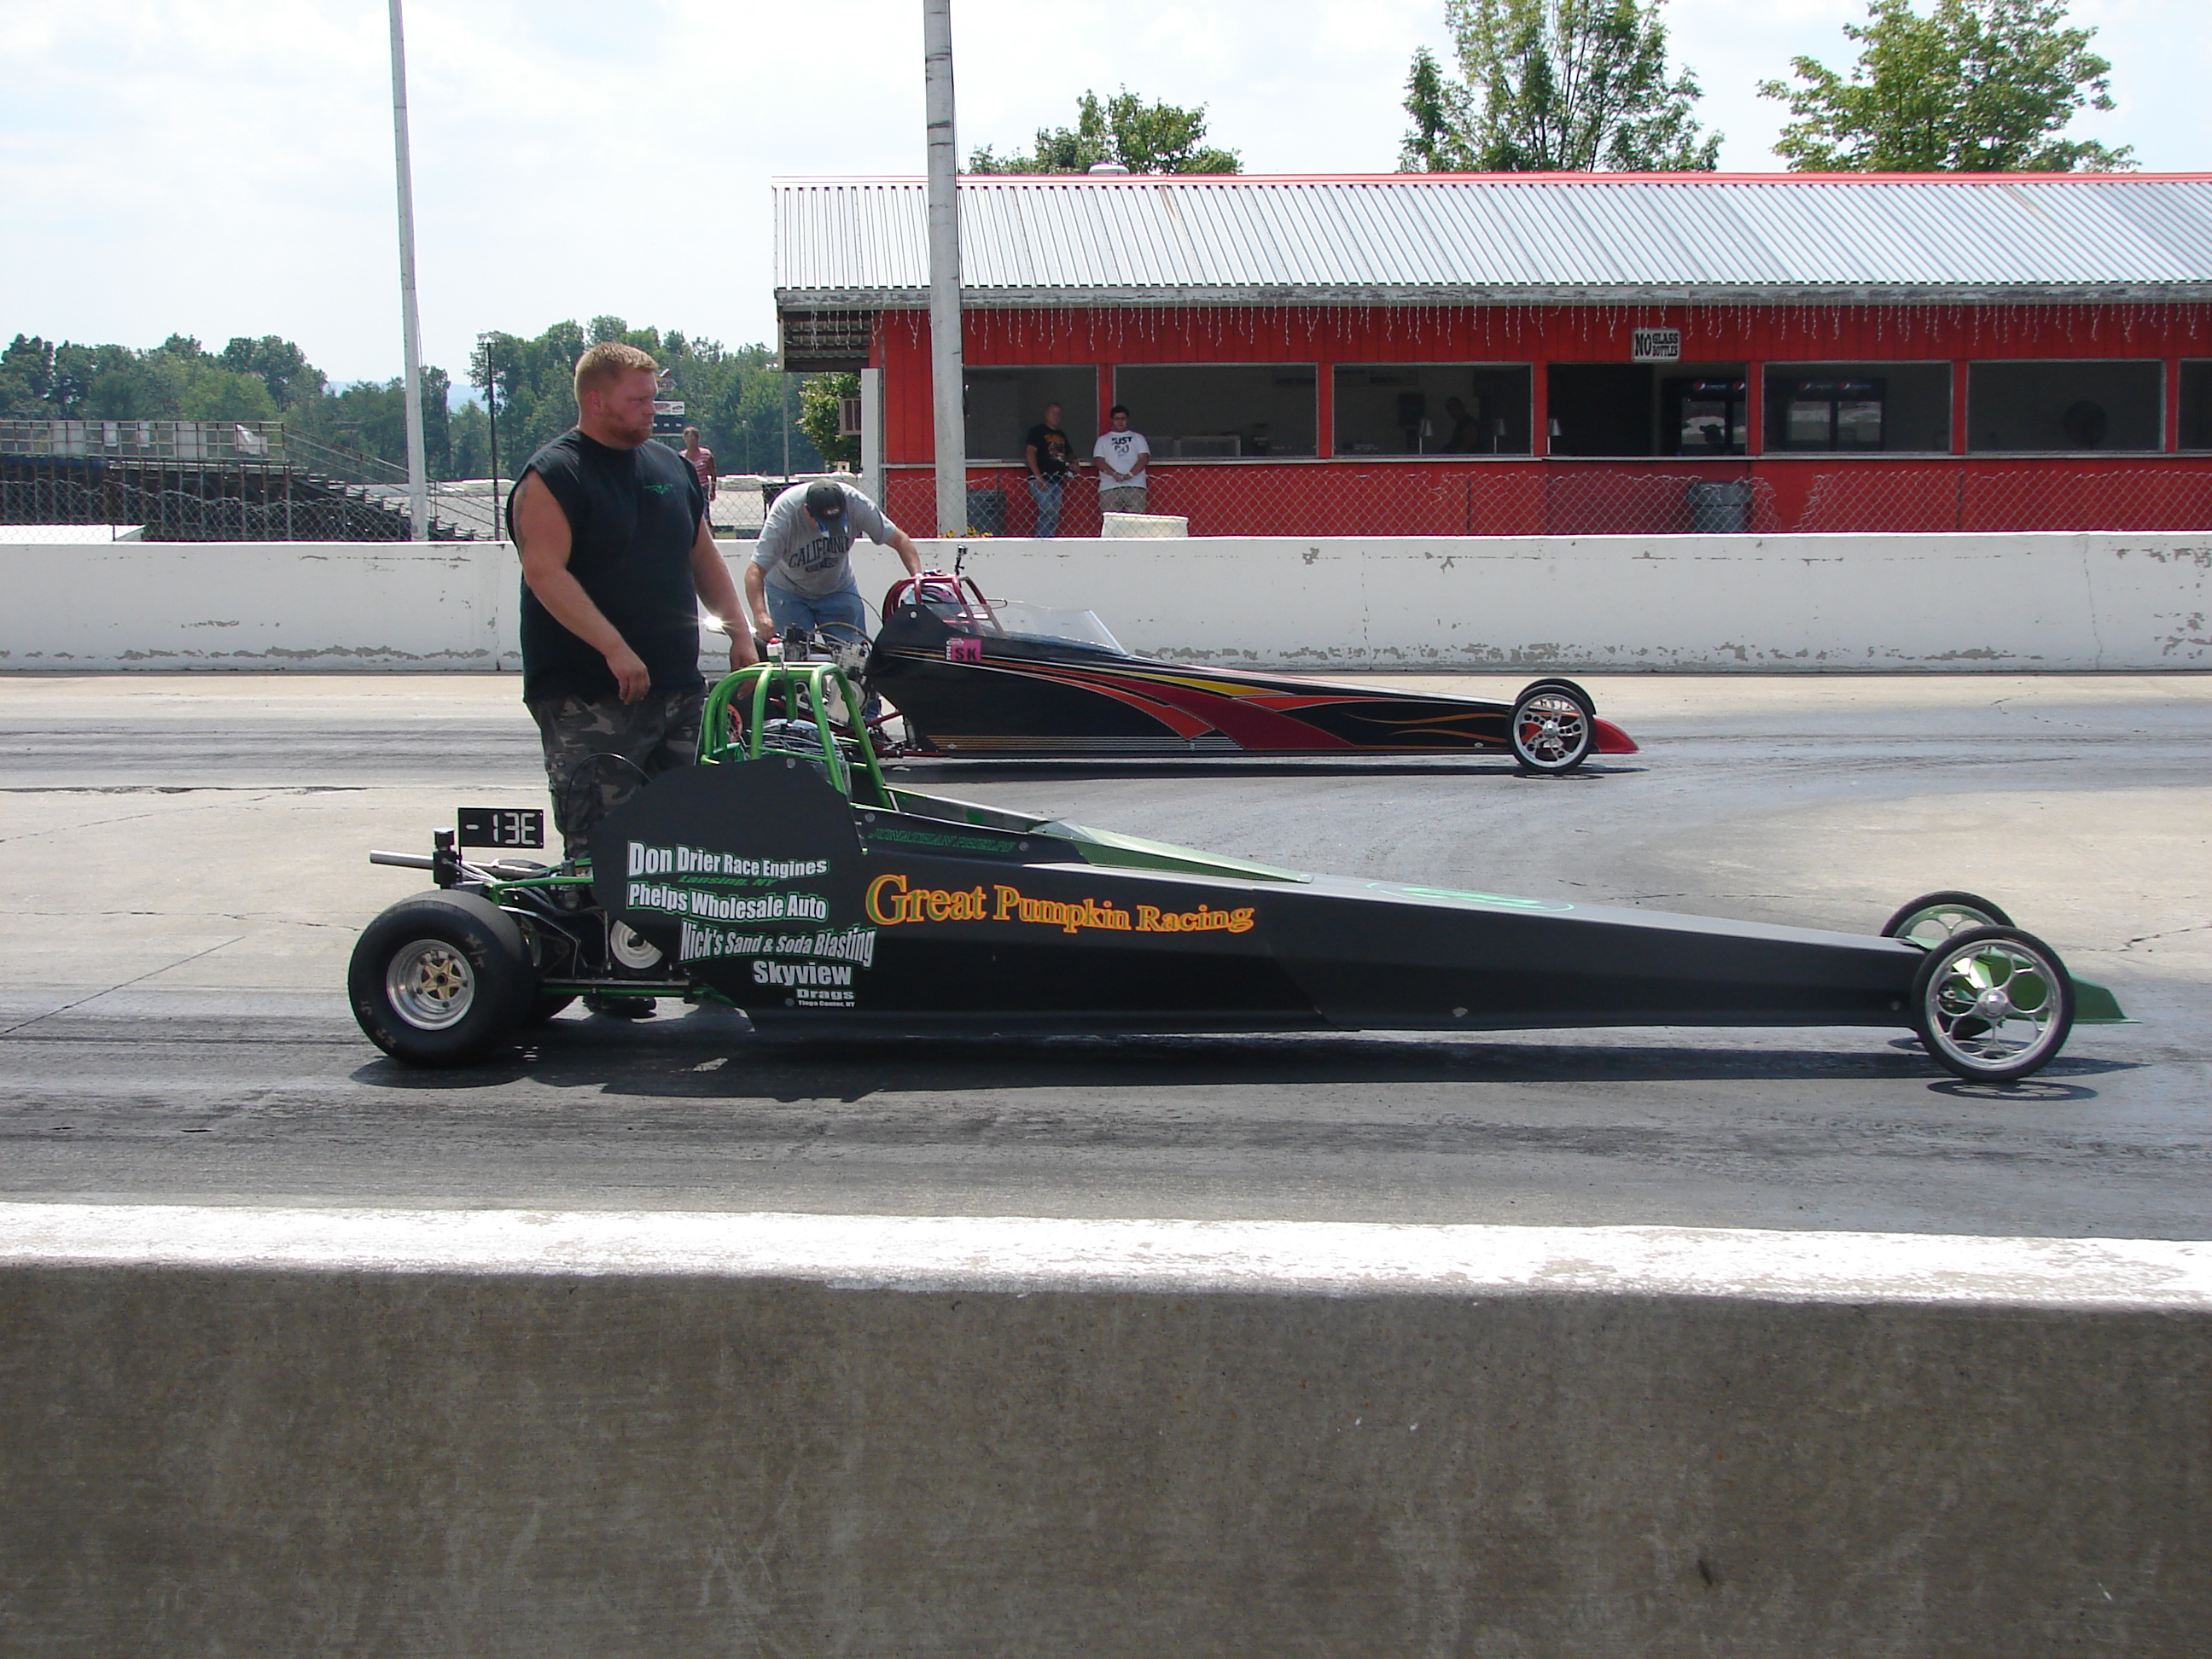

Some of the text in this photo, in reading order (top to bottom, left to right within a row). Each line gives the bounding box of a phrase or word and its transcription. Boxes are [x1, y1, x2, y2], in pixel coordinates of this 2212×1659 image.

[1635, 334, 1651, 356] NO
[1652, 333, 1678, 344] GLASS
[1652, 345, 1678, 357] BOTTLES
[628, 841, 828, 879] Don Drier Race Engines
[752, 878, 778, 887] NY
[628, 882, 828, 920] Phelps Wholesale Auto
[865, 874, 1254, 934] Great Pumpkin Racing
[679, 920, 876, 969] Nick's Sand & Soda Blasting
[753, 960, 852, 987] Skyview
[796, 988, 854, 1000] Drags
